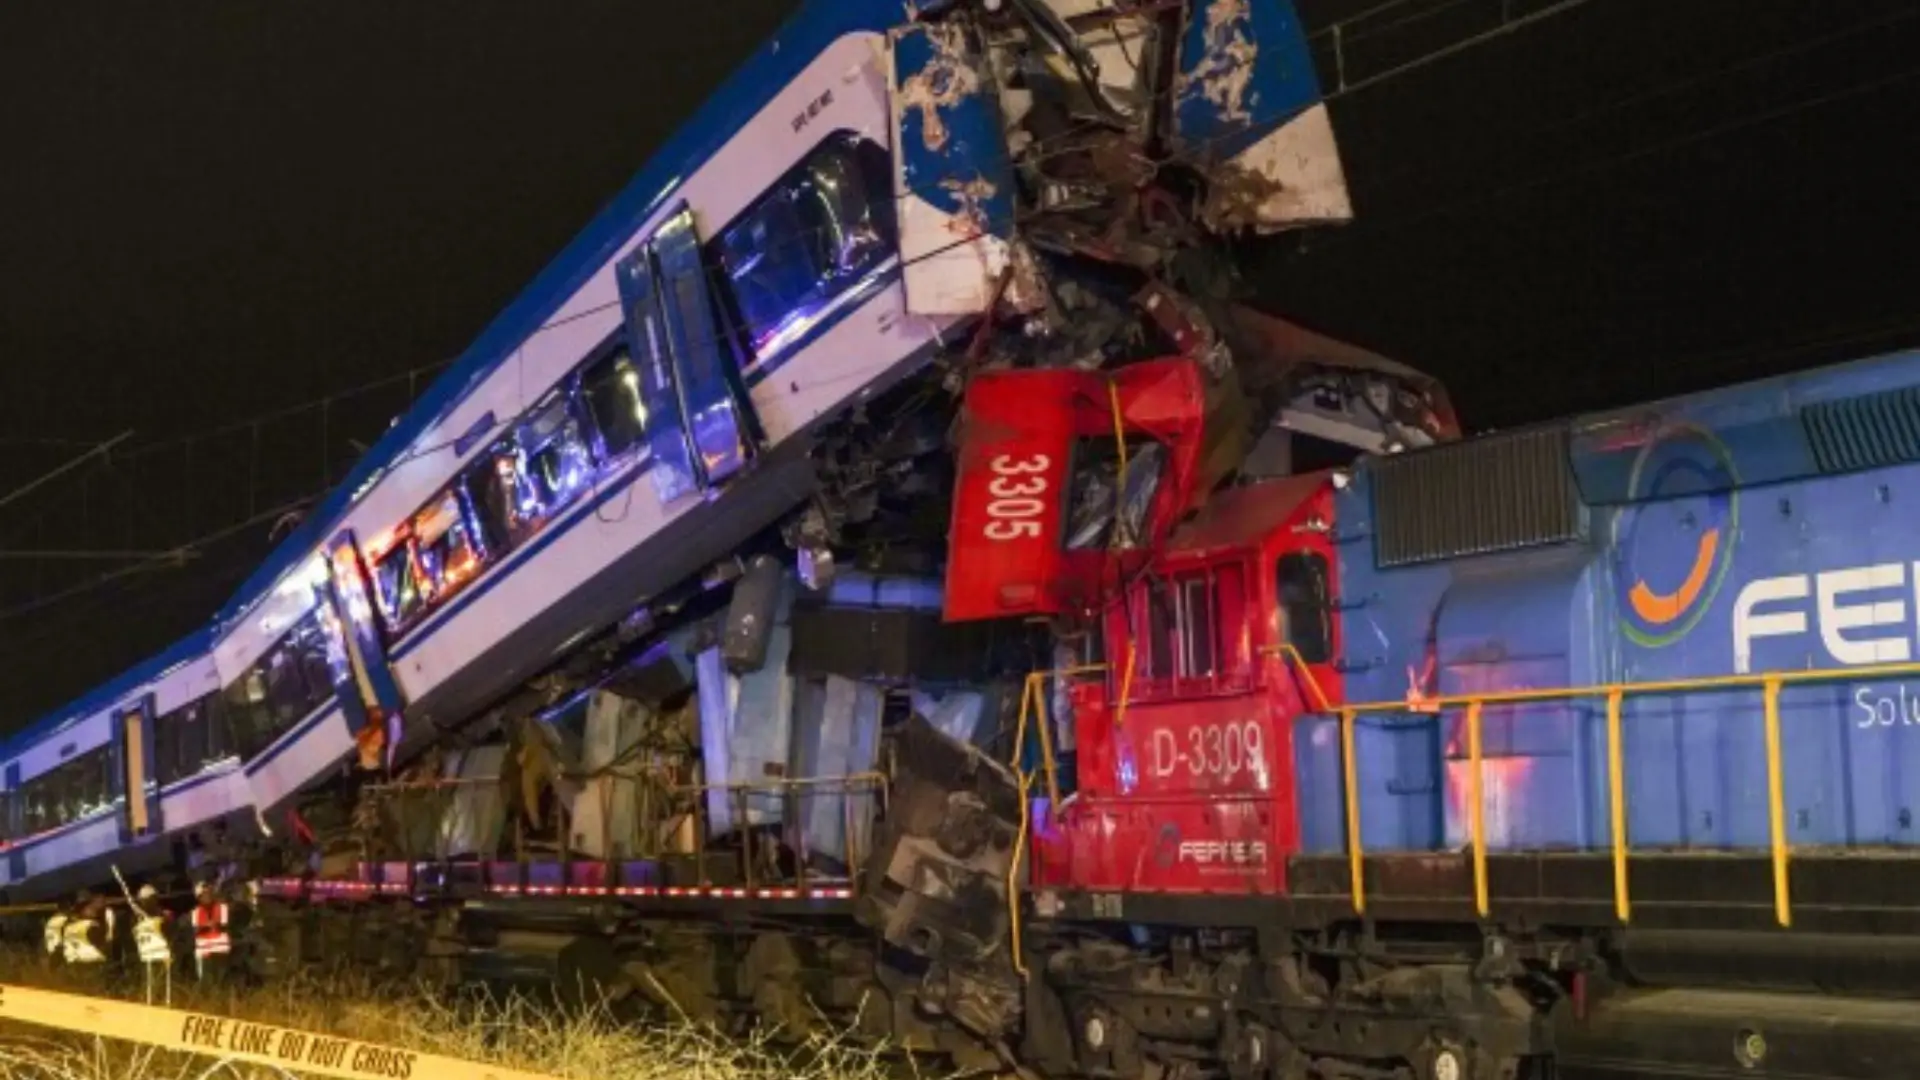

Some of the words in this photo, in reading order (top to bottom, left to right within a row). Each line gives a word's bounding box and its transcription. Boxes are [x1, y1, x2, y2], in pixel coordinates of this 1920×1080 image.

[983, 454, 1050, 540] 3305
[1733, 561, 1920, 673] FE
[1153, 720, 1264, 776] D-3309
[181, 1016, 224, 1049] FIRE
[230, 1020, 276, 1056] LINE
[278, 1031, 306, 1062] DO
[307, 1034, 350, 1068] NOT
[352, 1044, 418, 1079] CROSS
